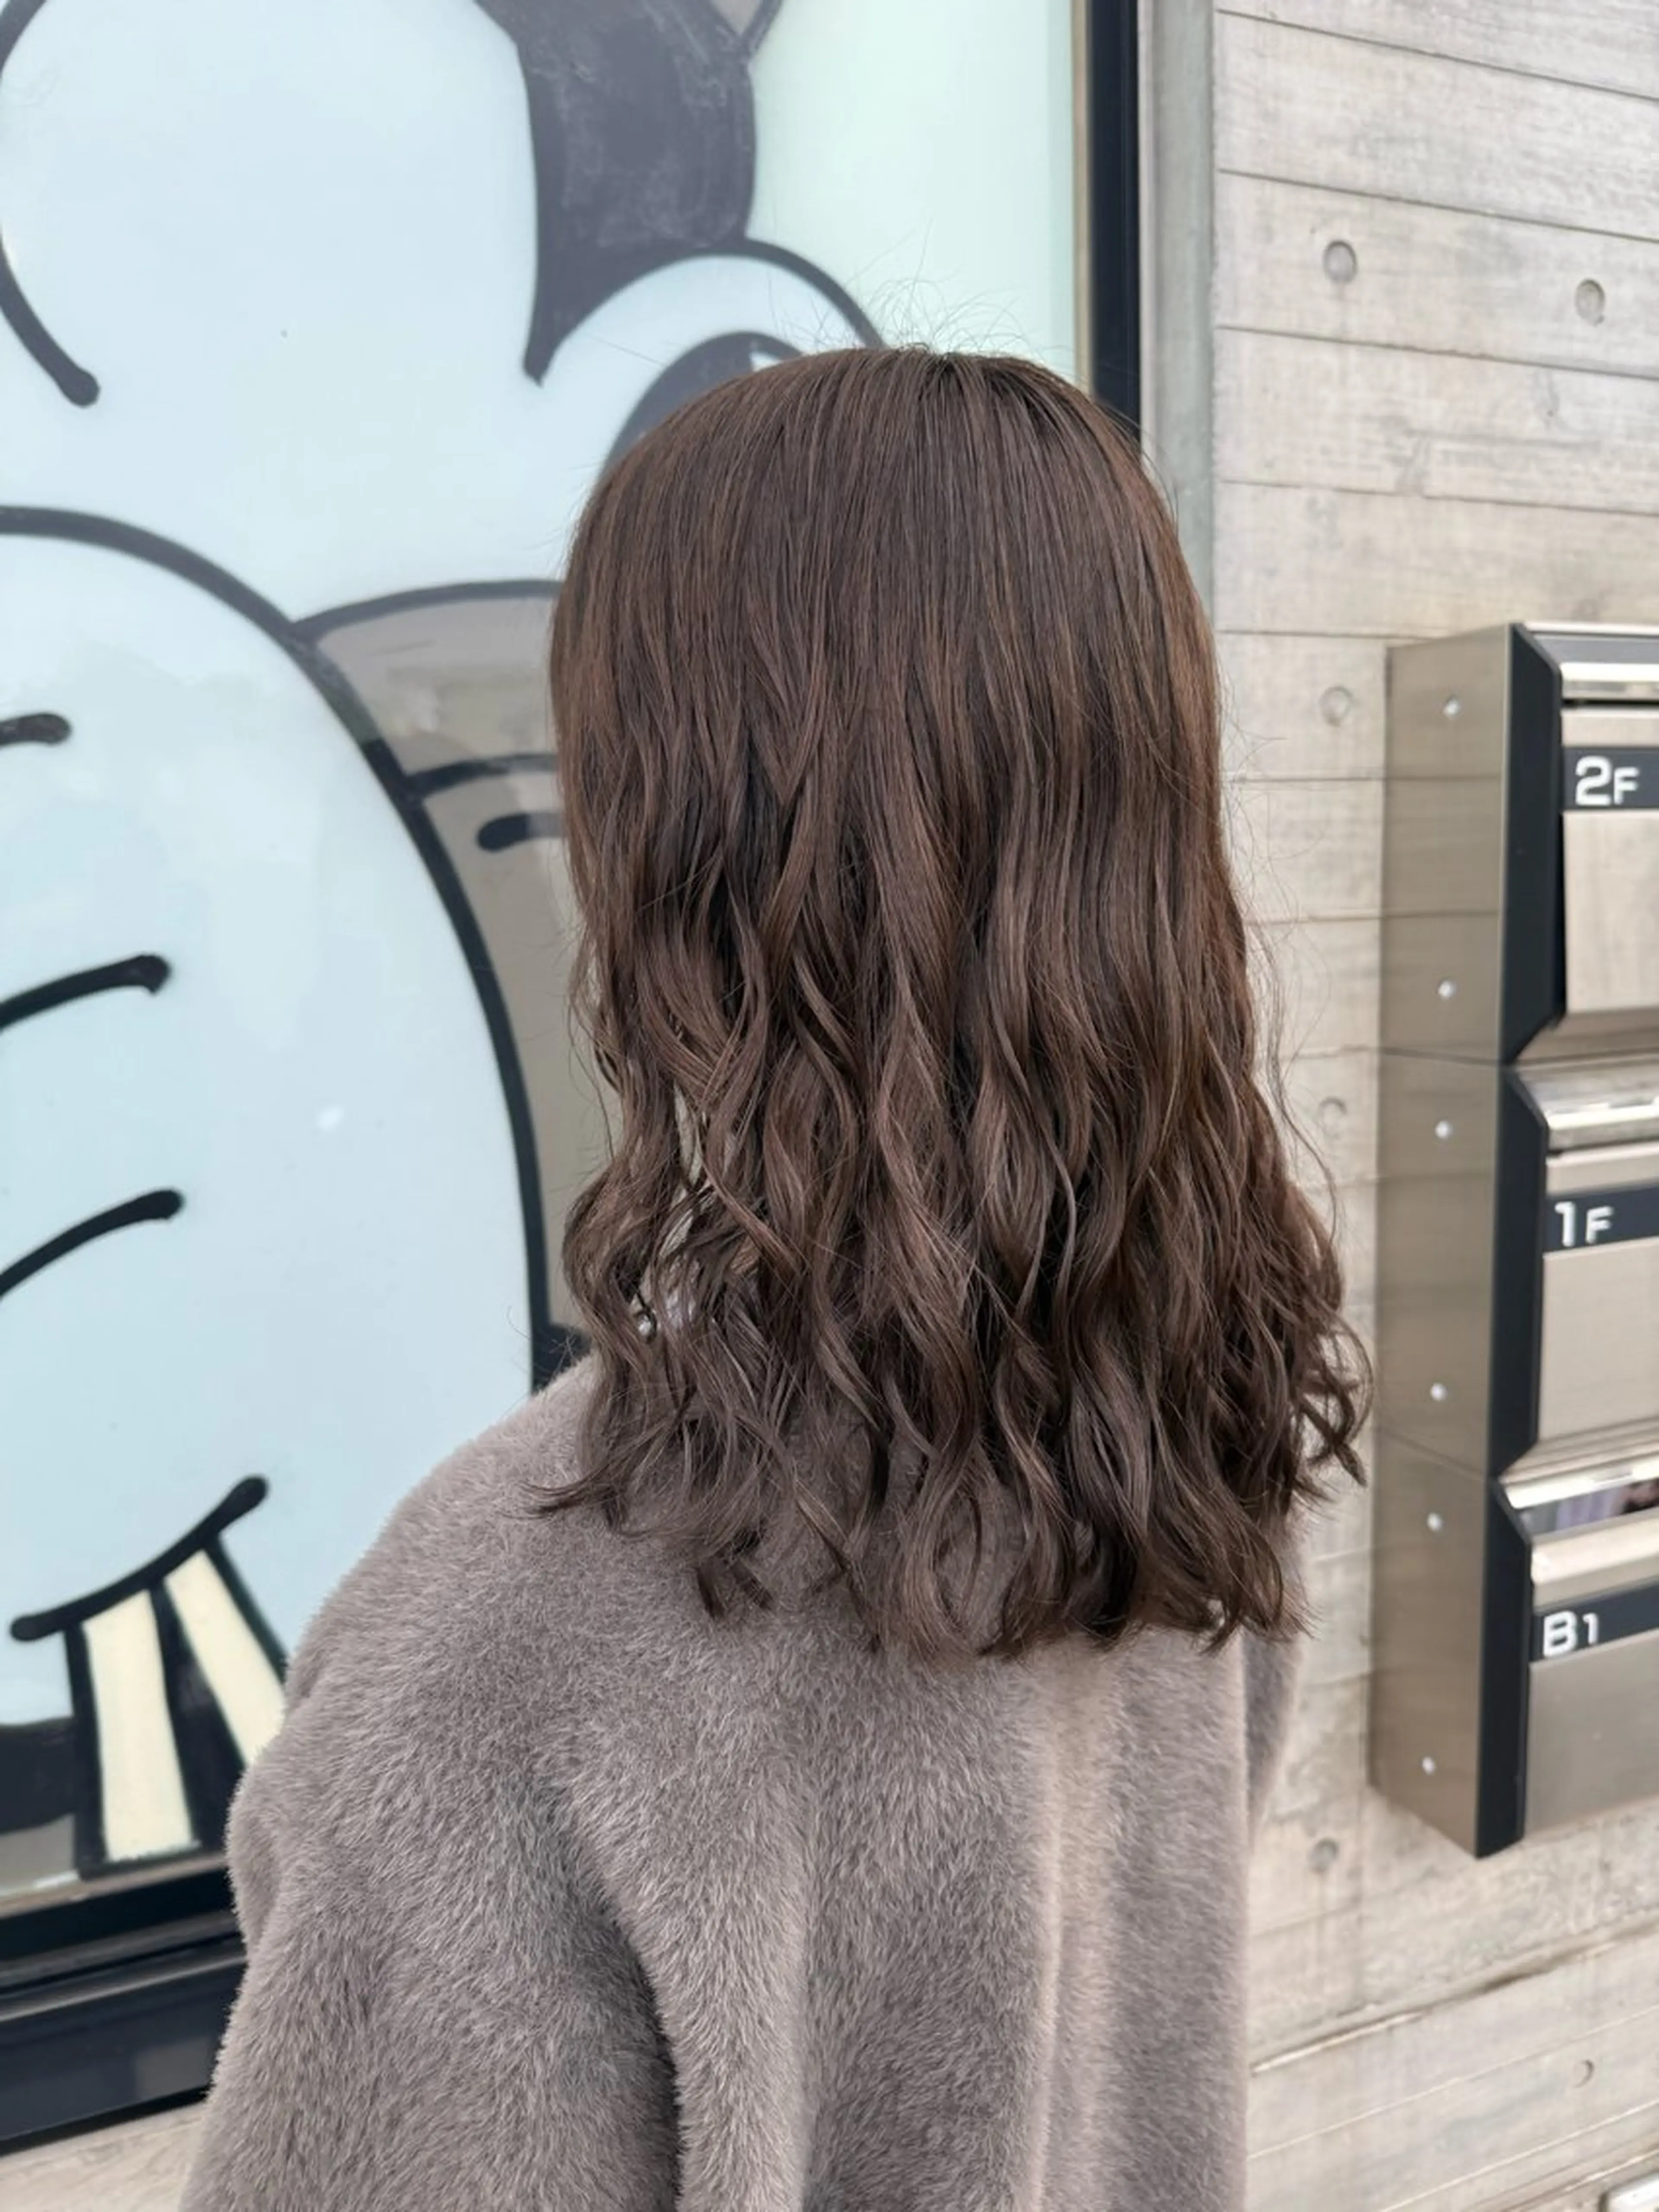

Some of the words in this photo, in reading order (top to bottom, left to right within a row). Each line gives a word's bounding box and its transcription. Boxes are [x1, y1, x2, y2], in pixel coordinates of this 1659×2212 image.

[1575, 755, 1639, 806] 2F
[1555, 1201, 1614, 1247] 1F
[1543, 1610, 1598, 1657] B1
